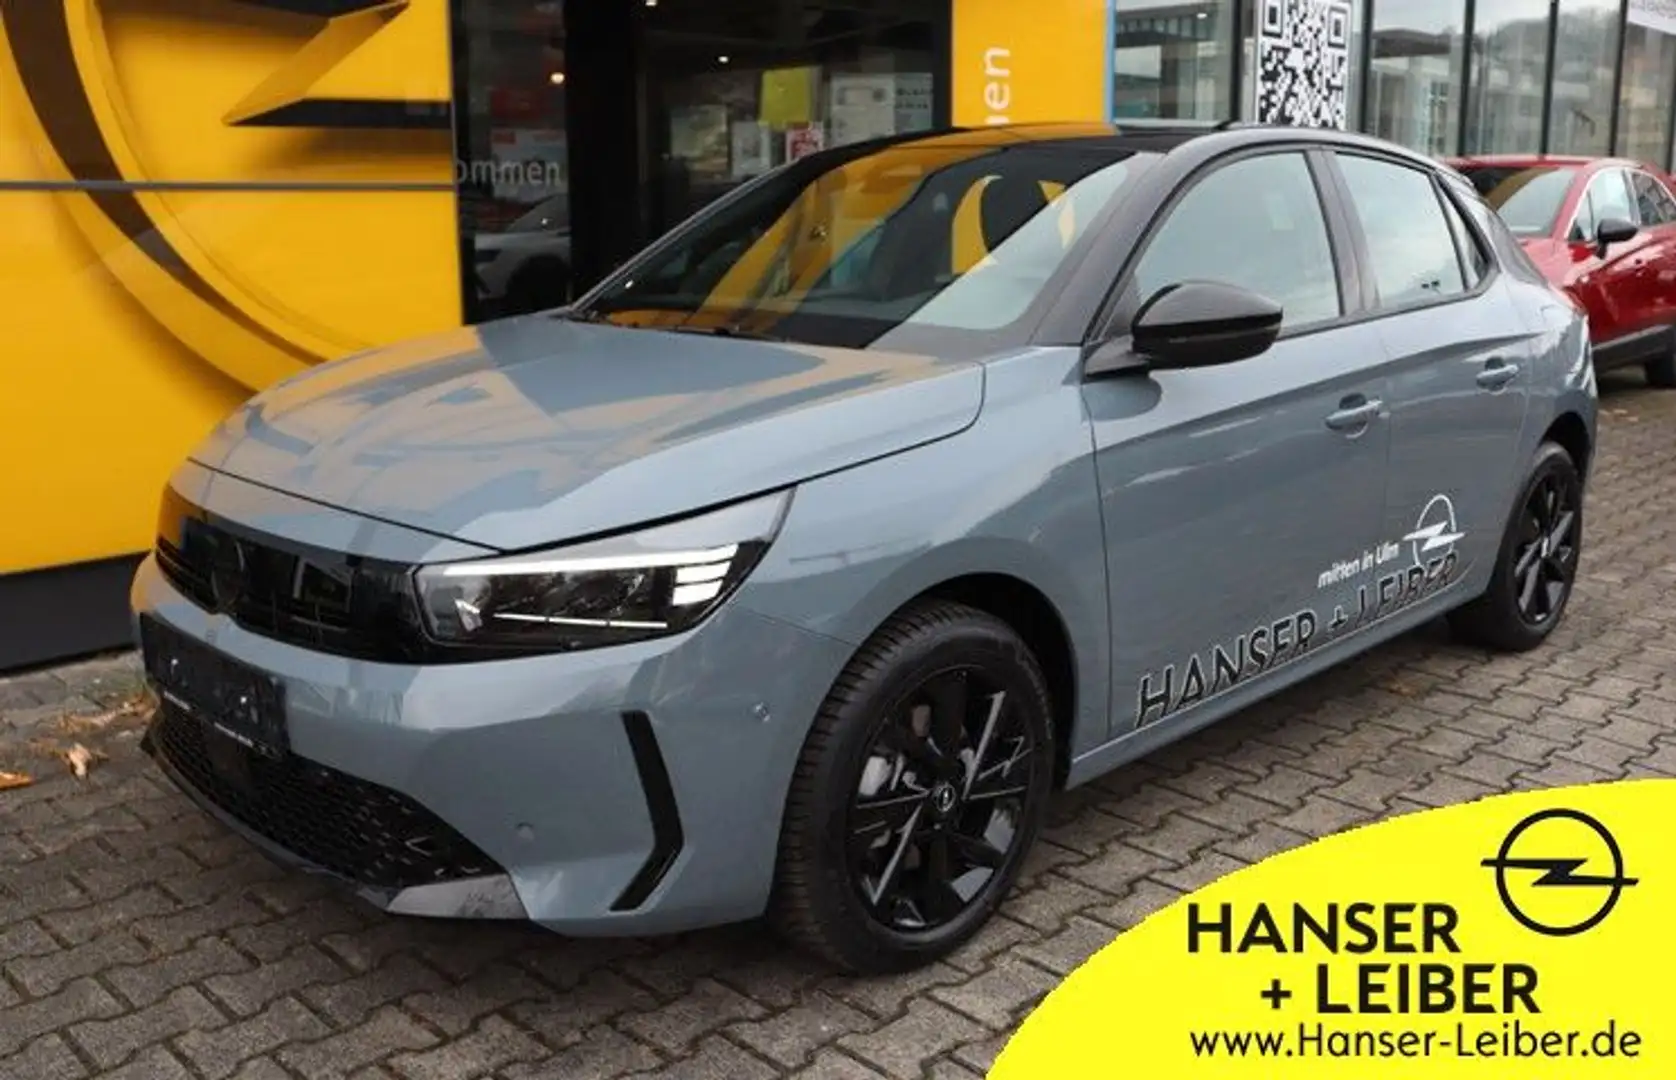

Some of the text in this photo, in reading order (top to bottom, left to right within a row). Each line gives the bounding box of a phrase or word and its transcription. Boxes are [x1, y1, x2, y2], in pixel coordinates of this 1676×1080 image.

[1317, 540, 1399, 588] mitten in Ulm
[1134, 608, 1317, 728] HANSER
[1354, 549, 1460, 628] LEIBER
